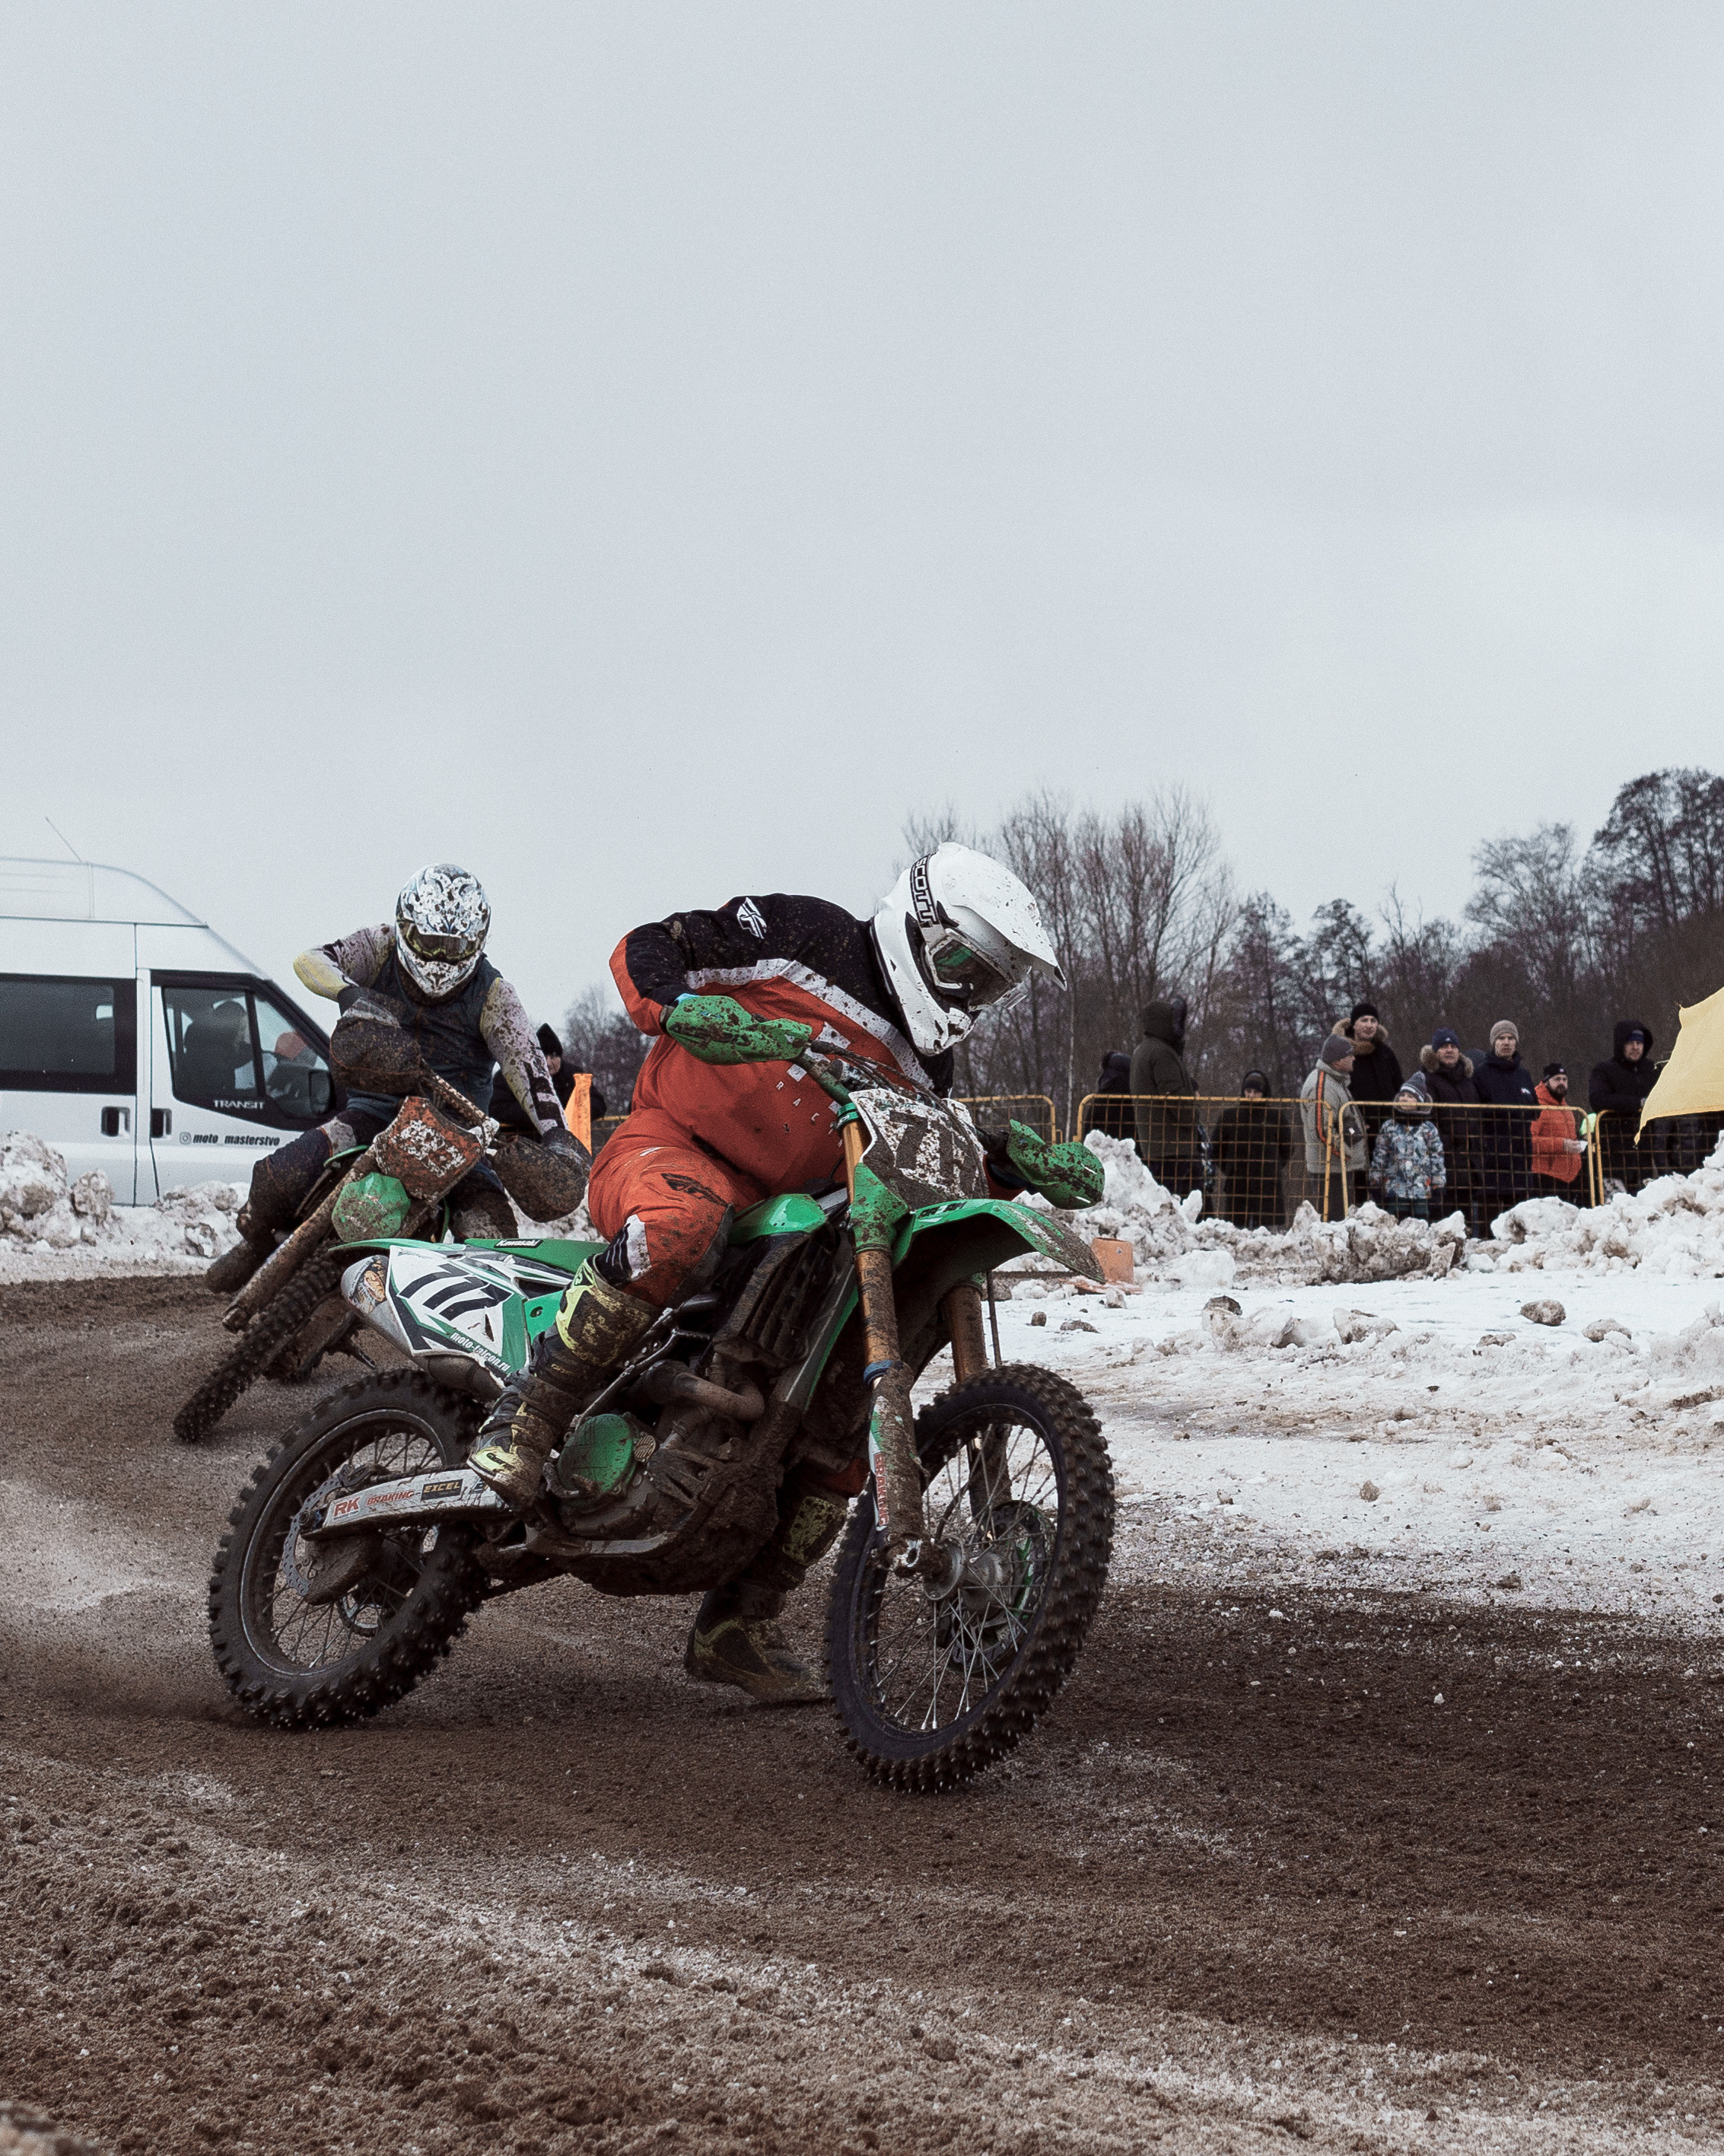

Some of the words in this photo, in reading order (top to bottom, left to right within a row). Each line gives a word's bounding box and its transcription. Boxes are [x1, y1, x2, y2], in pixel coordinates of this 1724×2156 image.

[914, 857, 937, 922] SCOTT
[214, 1100, 264, 1109] TRANSIT
[450, 1333, 511, 1371] moto-falcon.ru
[424, 1482, 460, 1492] EXCEL
[874, 1453, 889, 1526] BRAKING
[333, 1497, 361, 1517] RK
[367, 1491, 415, 1505] BRAKING
